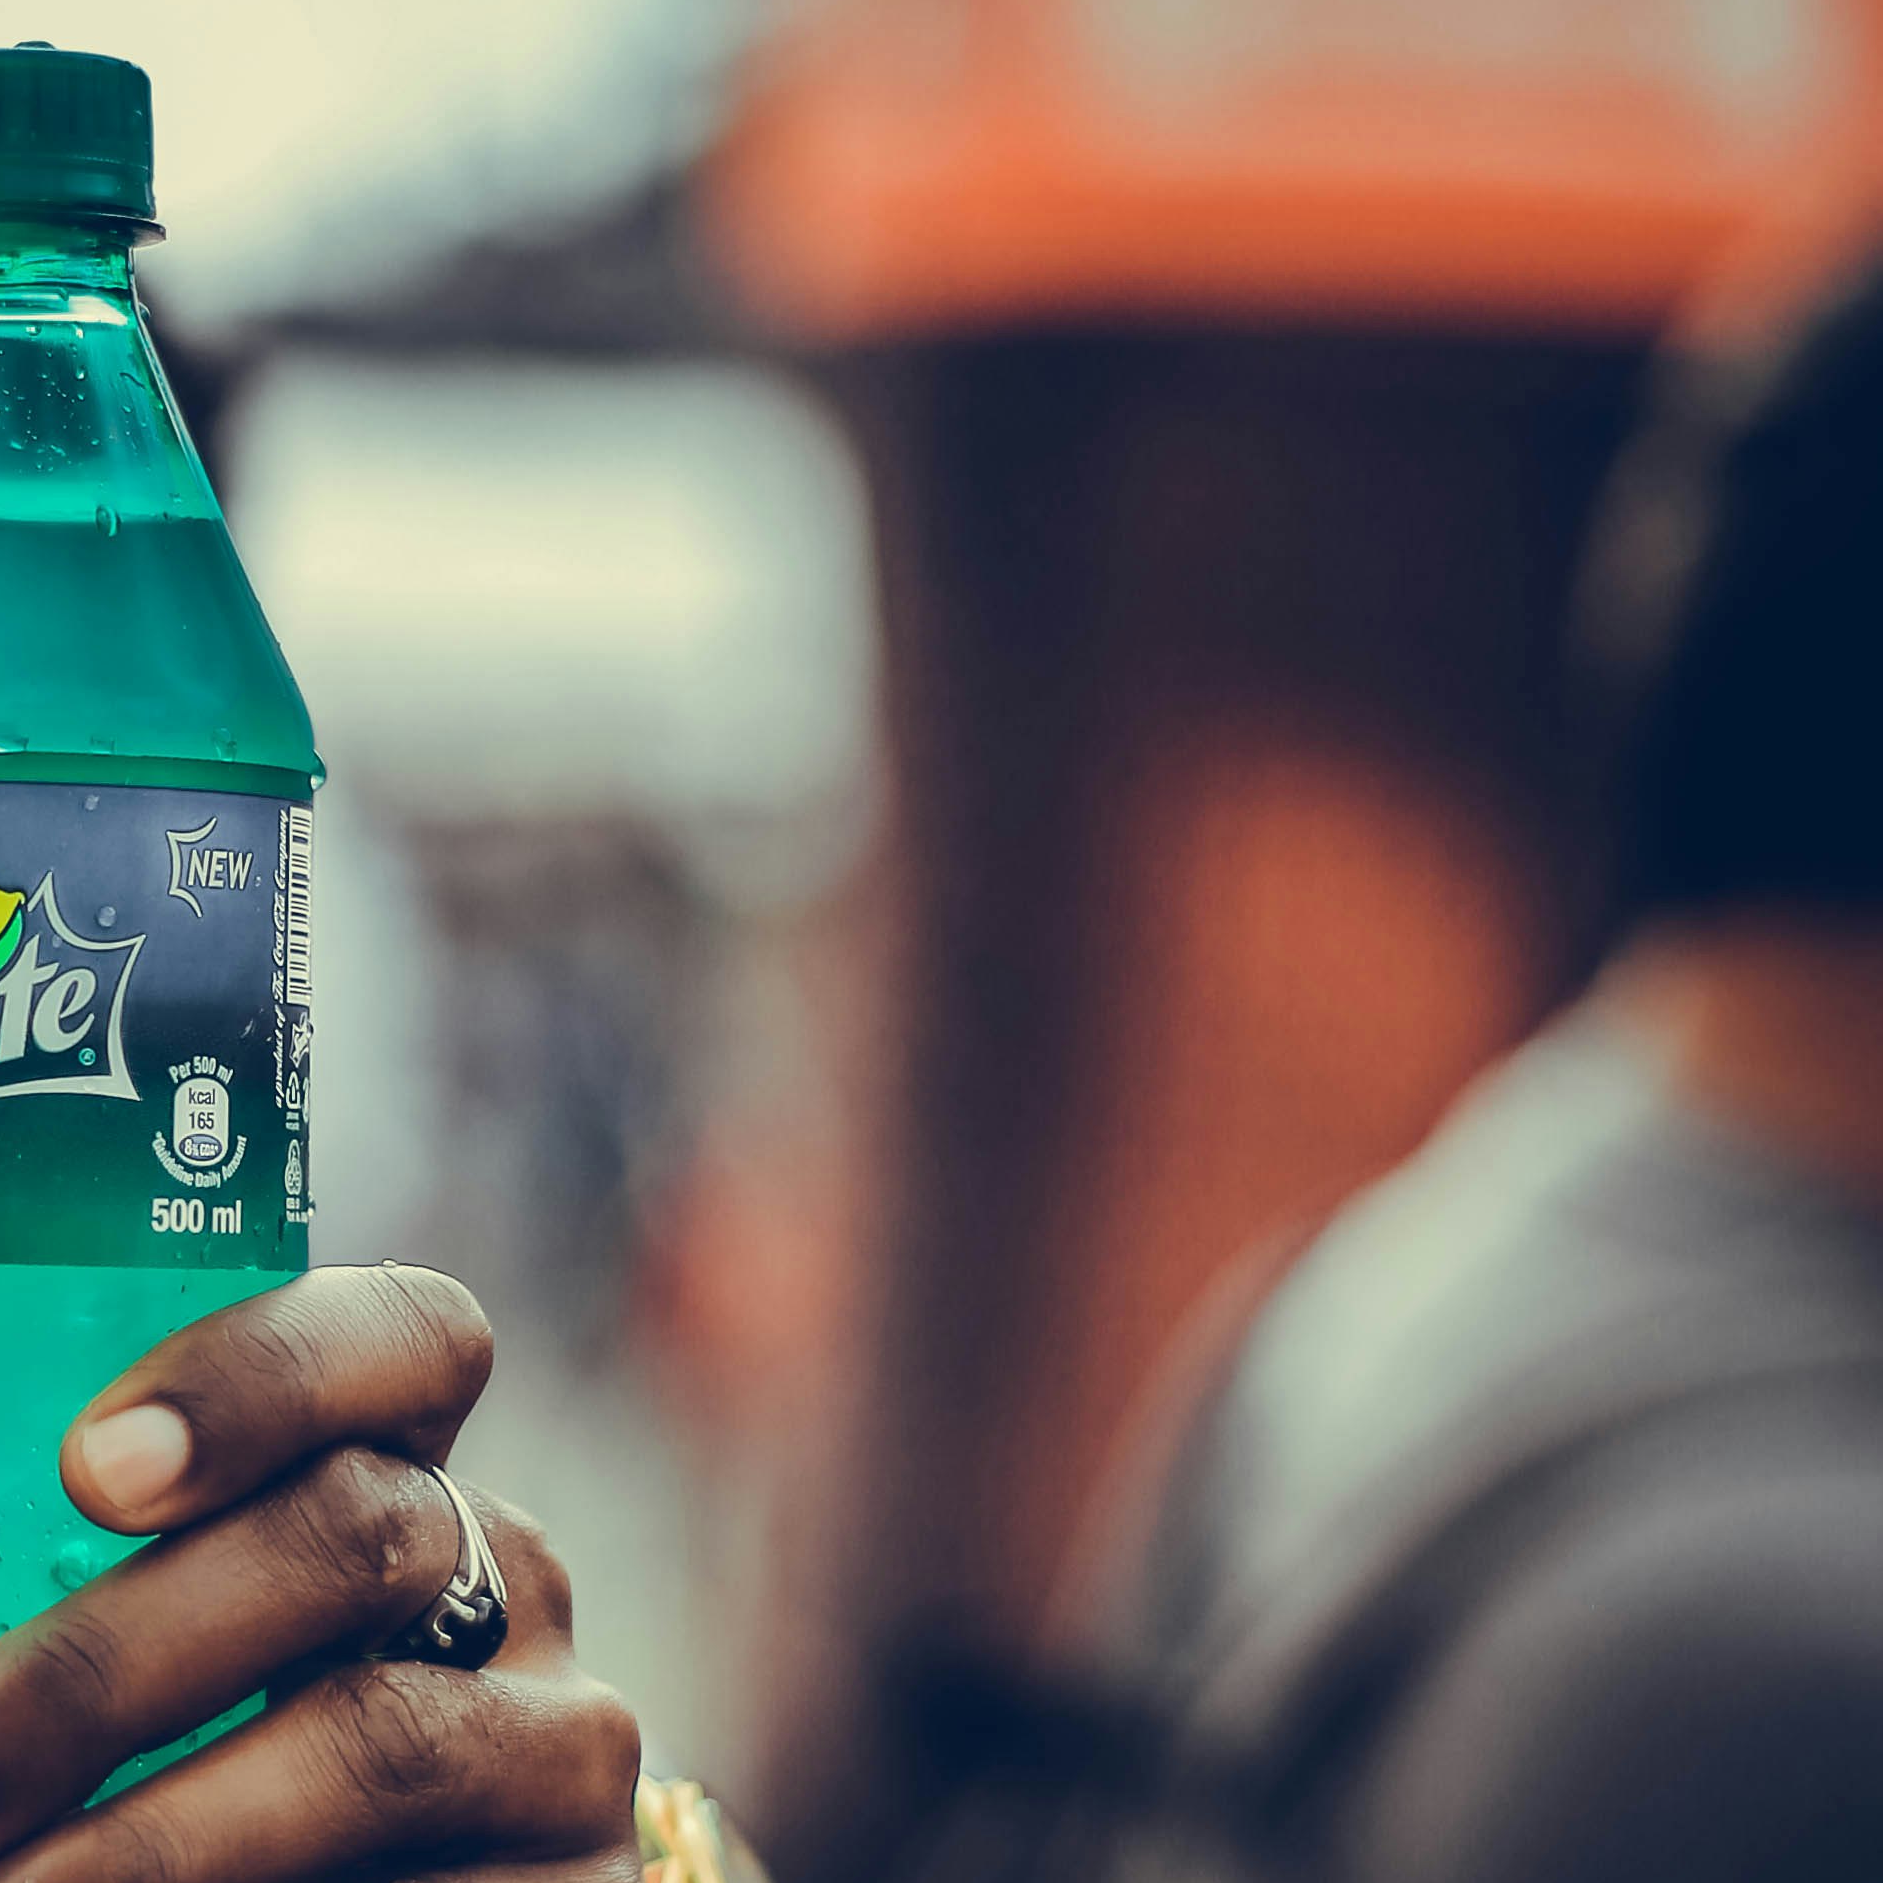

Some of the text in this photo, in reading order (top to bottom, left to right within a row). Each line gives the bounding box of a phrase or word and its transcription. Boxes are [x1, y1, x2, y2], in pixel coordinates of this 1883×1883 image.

[187, 849, 253, 890] NEW
[168, 1055, 234, 1085] Per 500 ml
[188, 1087, 216, 1105] kcal
[189, 1111, 215, 1130] 165
[194, 1170, 221, 1189] Daily
[150, 1197, 205, 1234] 500
[212, 1199, 242, 1235] ml
